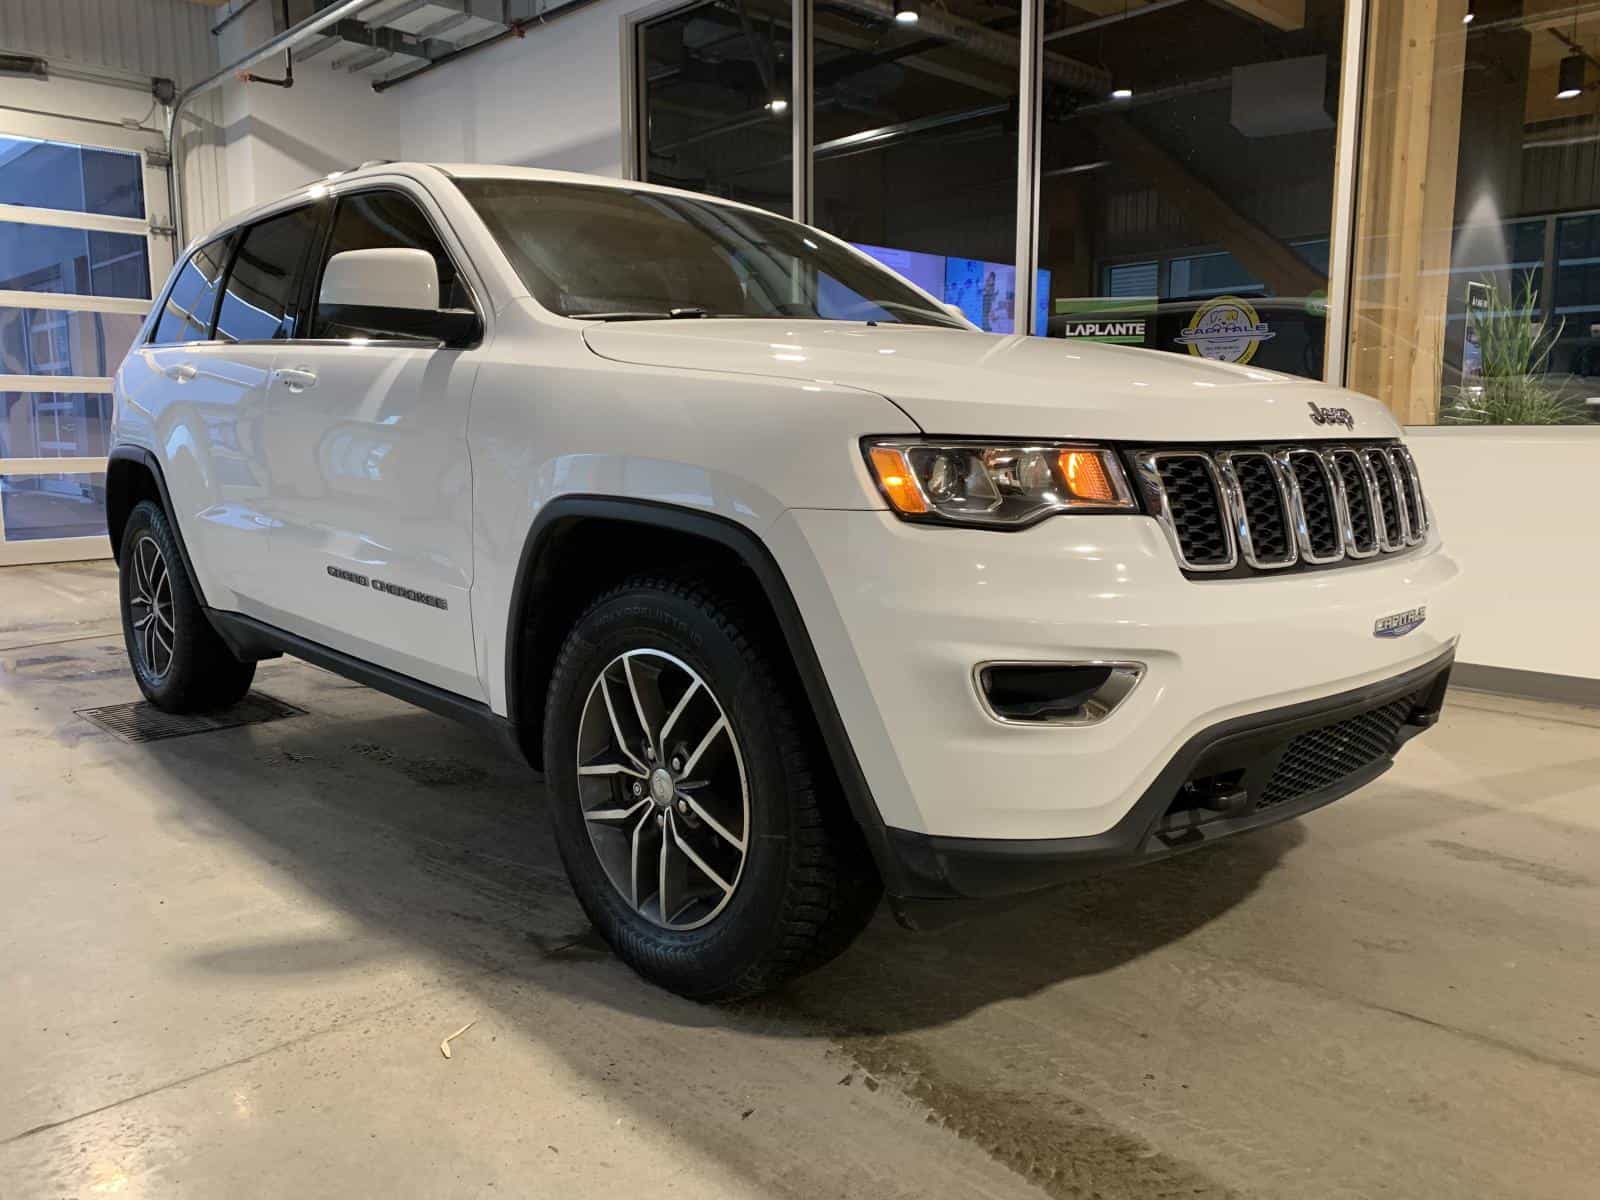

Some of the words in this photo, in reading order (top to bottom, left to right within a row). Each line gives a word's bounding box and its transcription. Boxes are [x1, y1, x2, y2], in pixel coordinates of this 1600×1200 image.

[1065, 322, 1146, 337] LAPLANTE
[1181, 323, 1268, 336] CAPITALE
[1307, 401, 1354, 432] Jeep
[327, 566, 369, 587] GRAND
[371, 579, 448, 611] CHEROKEE
